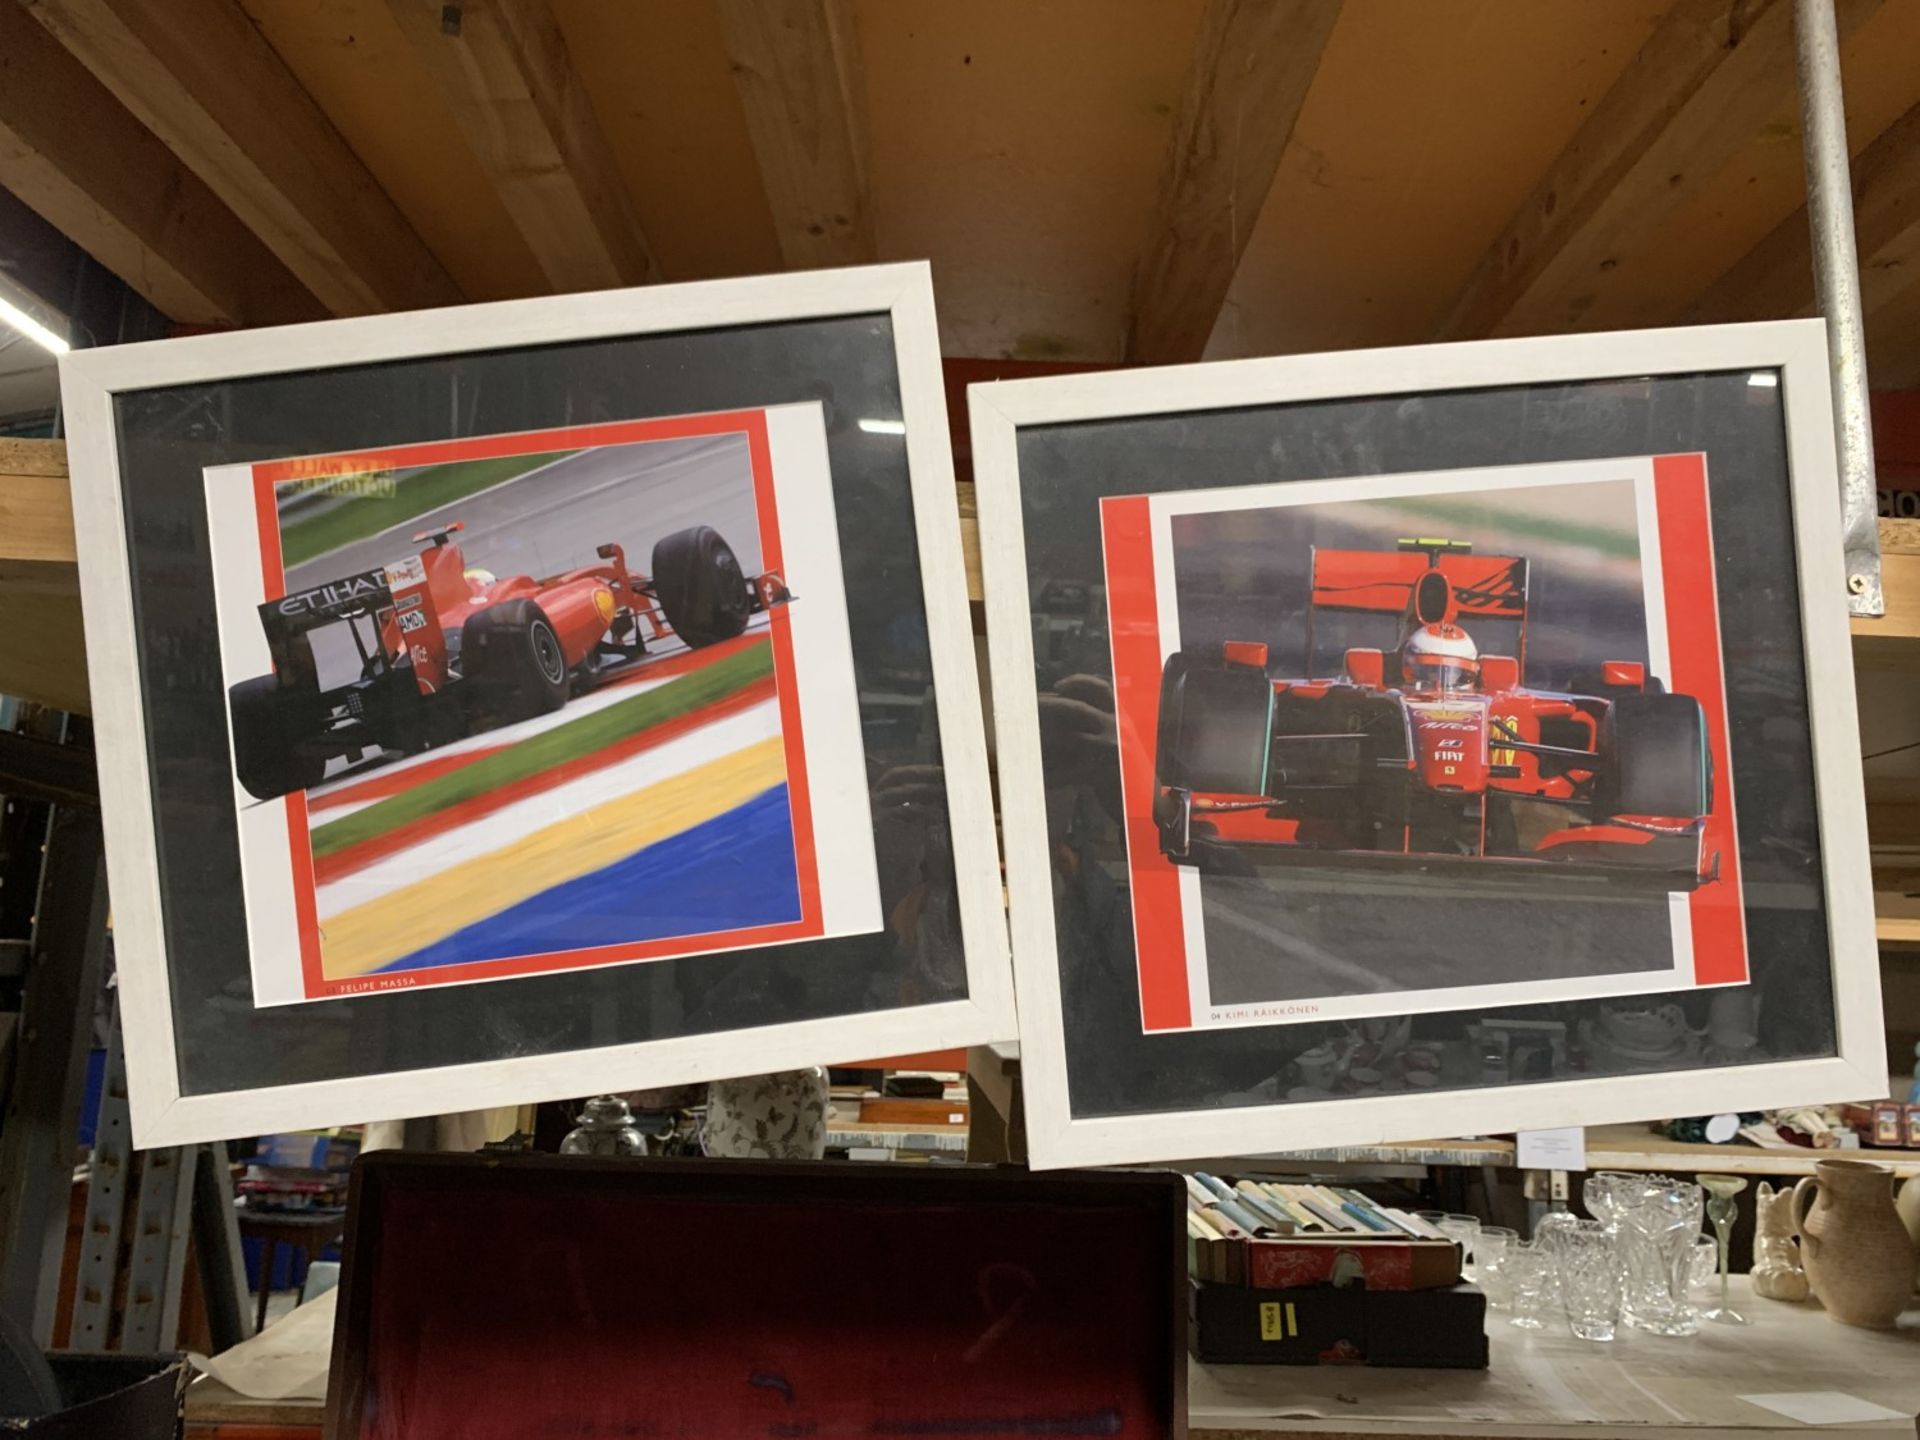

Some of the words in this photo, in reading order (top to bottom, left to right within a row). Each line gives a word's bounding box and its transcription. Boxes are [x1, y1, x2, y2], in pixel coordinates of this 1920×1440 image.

[1434, 750, 1464, 762] FIAT
[340, 981, 375, 993] FELIPE
[380, 976, 416, 989] MASSA
[1225, 1010, 1249, 1020] KIMI
